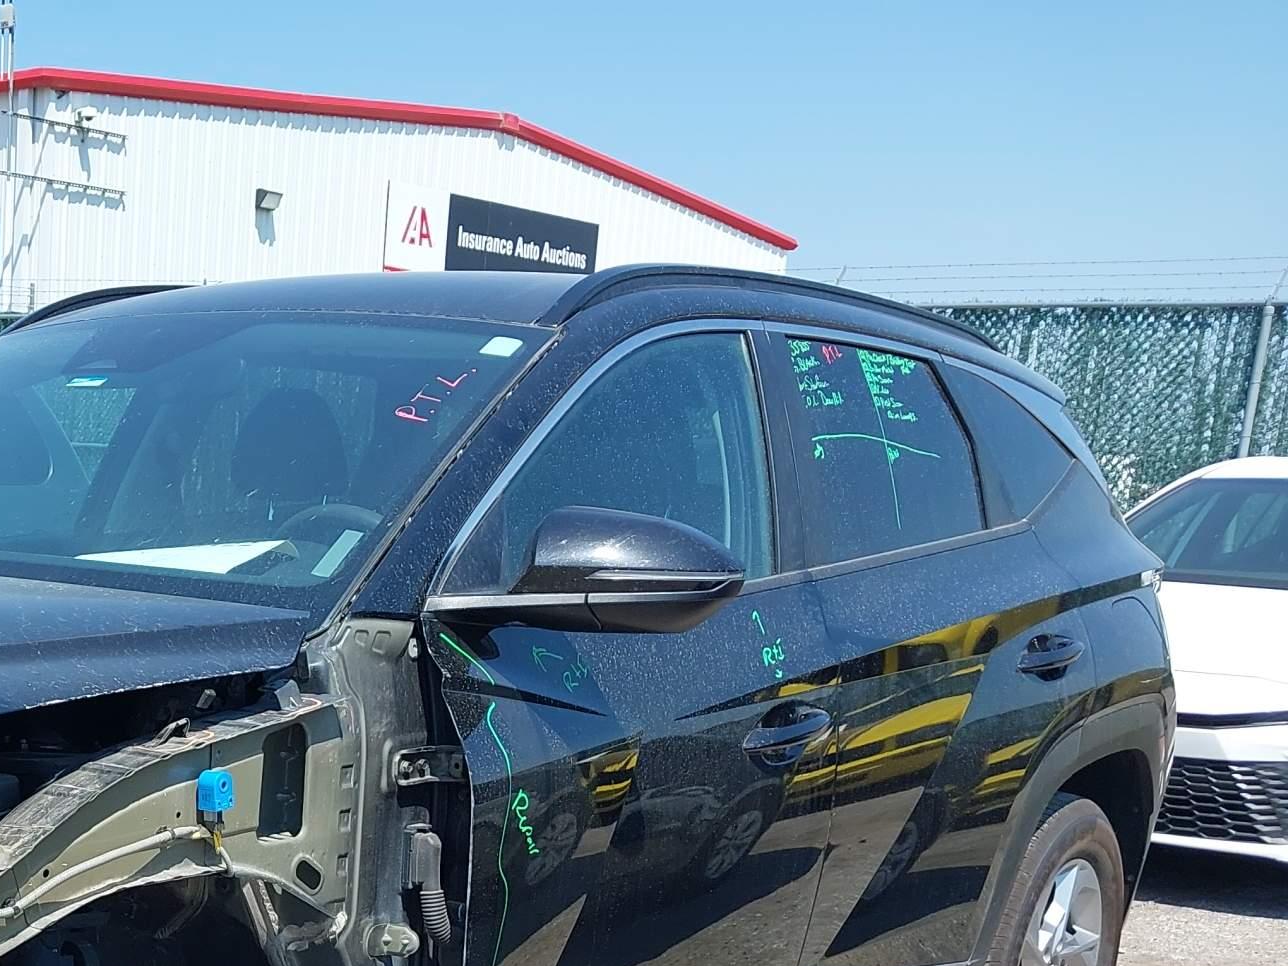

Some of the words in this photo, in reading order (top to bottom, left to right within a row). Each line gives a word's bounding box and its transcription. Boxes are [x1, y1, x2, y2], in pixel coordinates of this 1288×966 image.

[457, 224, 513, 256] Insurance
[515, 236, 540, 261] Auto
[541, 241, 587, 270] Auctions
